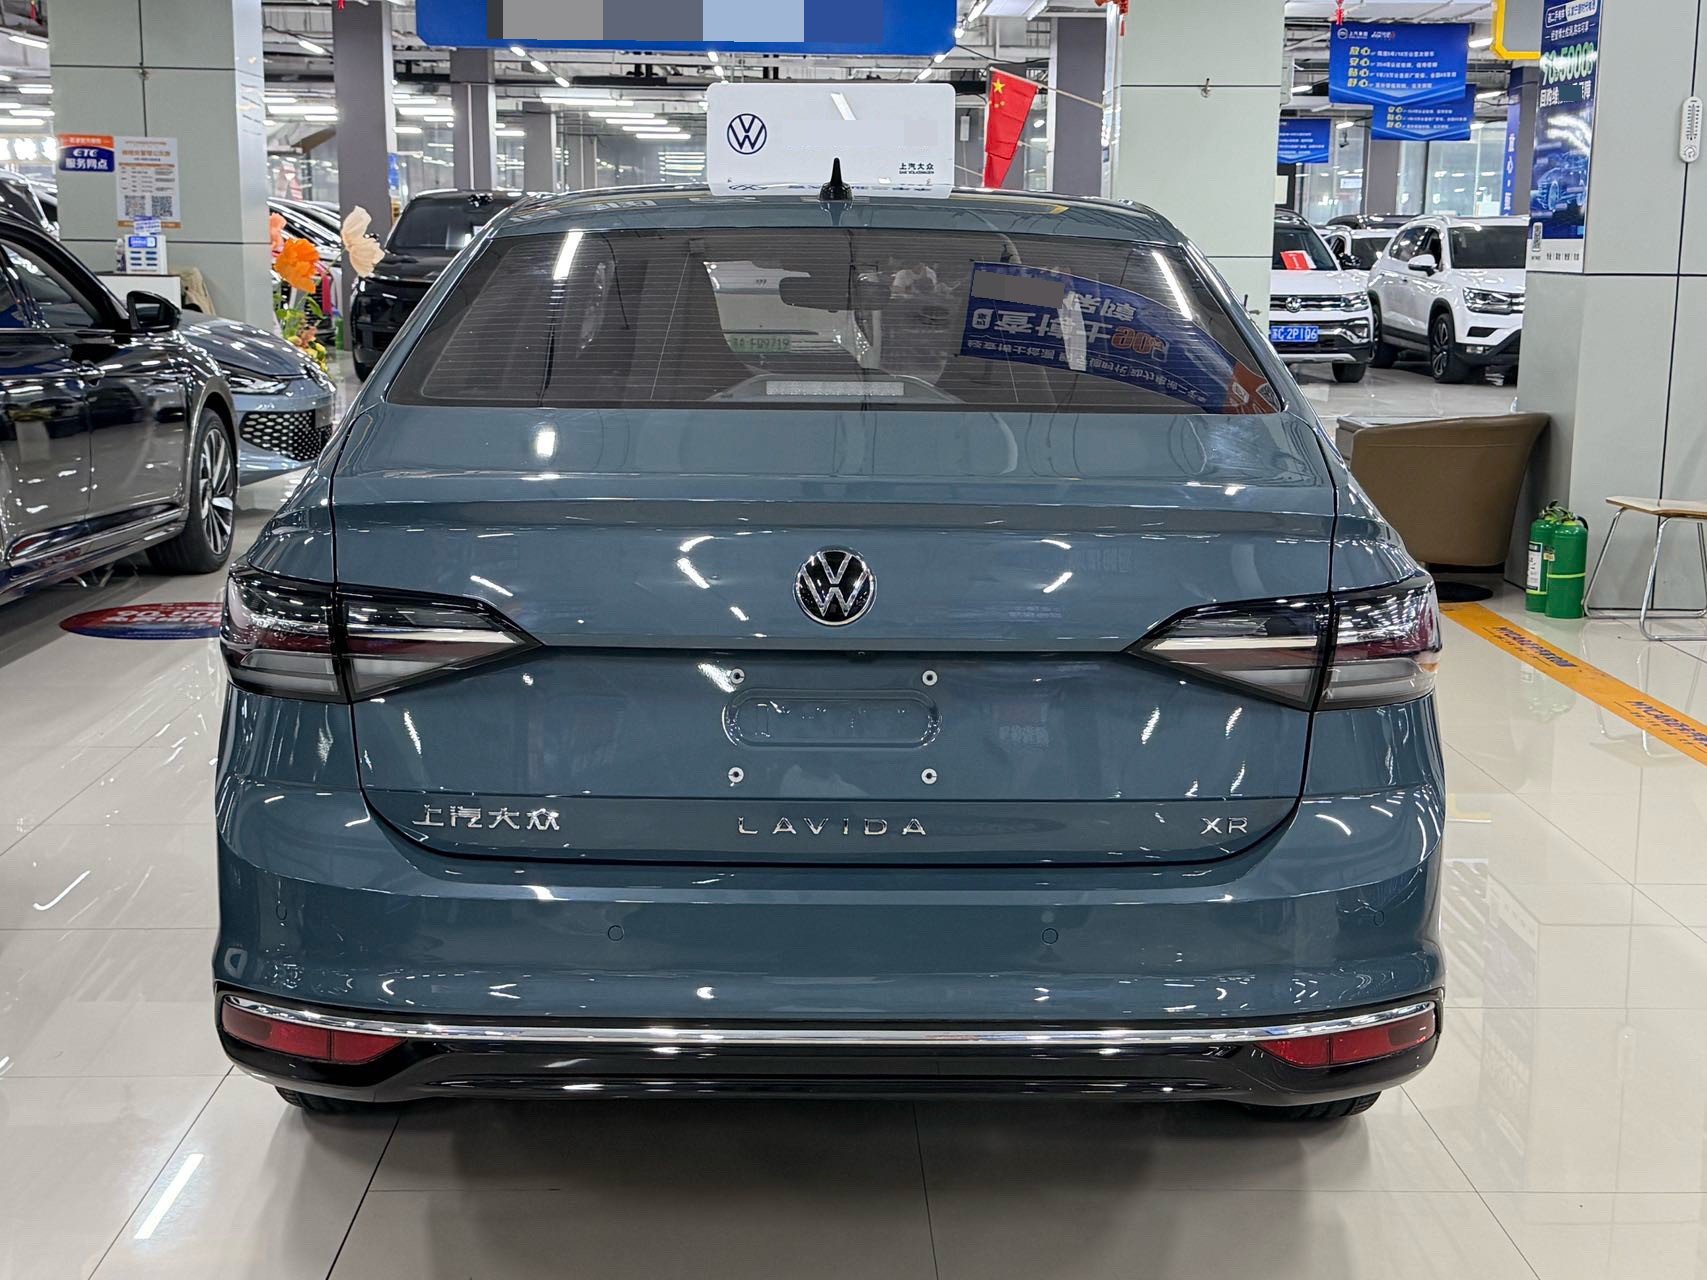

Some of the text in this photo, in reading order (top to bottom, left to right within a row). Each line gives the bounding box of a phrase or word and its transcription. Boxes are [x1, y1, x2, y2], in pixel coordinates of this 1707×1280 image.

[73, 148, 98, 157] ETC
[65, 158, 108, 170] 服务网点
[899, 162, 934, 170] 上汽大众
[412, 804, 561, 832] 上汽大众
[738, 816, 927, 836] LAVIDA
[1200, 817, 1248, 835] XR
